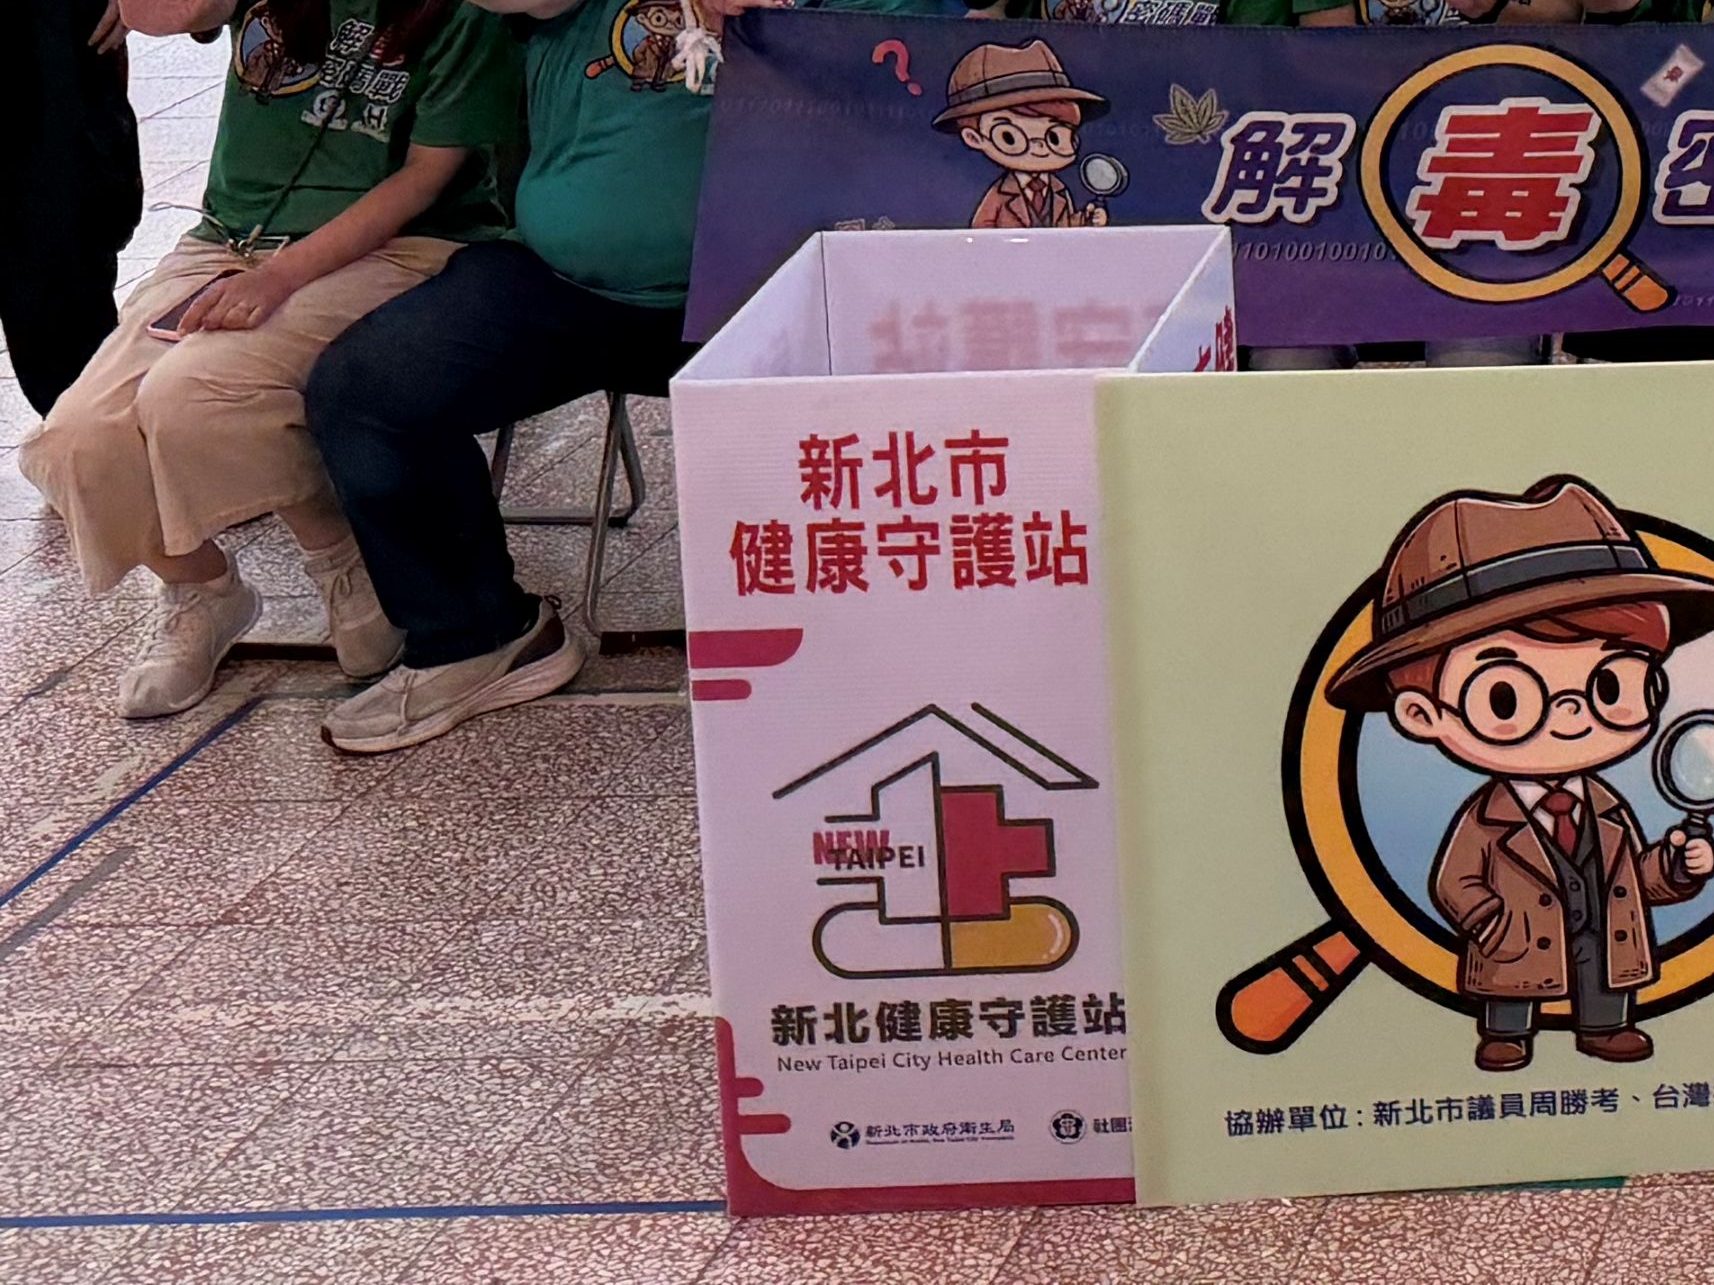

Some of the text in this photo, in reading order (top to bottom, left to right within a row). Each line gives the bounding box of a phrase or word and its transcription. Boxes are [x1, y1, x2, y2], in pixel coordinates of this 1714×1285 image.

[798, 430, 1009, 509] 新北市
[729, 510, 1089, 597] 健康守護站
[831, 845, 926, 871] TAIPEI
[770, 992, 1127, 1047] 新北健康守護站
[777, 1045, 1127, 1074] New Taipei City Health Care Center
